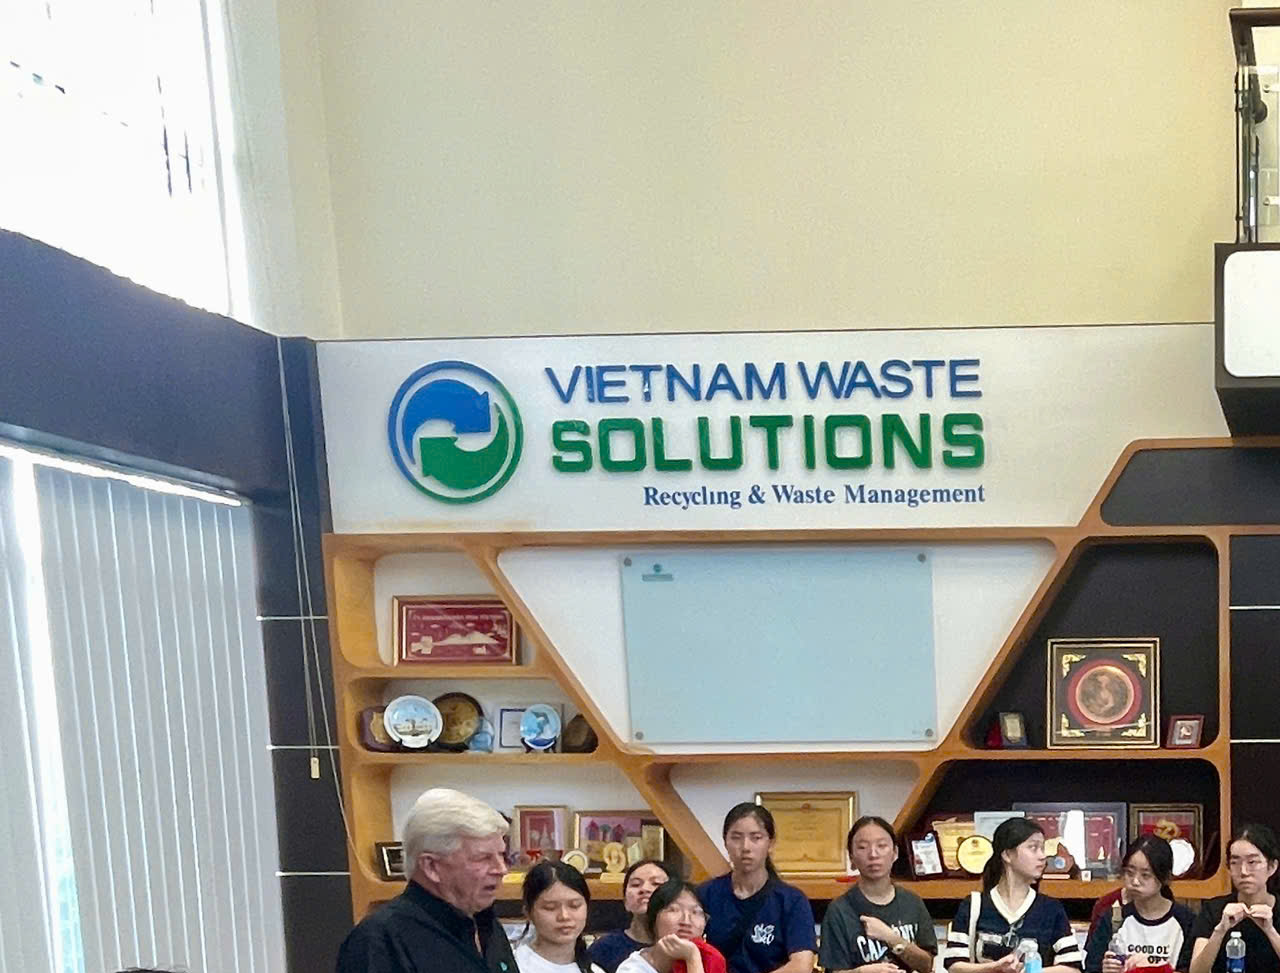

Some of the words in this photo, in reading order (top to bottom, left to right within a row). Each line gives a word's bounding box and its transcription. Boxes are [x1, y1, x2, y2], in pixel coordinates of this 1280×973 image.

[544, 362, 787, 404] VIETNAM
[797, 358, 983, 400] WASTE
[551, 412, 985, 473] SOLUTIONS
[643, 486, 742, 510] Recycling
[748, 484, 766, 504] &
[771, 484, 836, 504] Waste
[845, 484, 986, 508] Management
